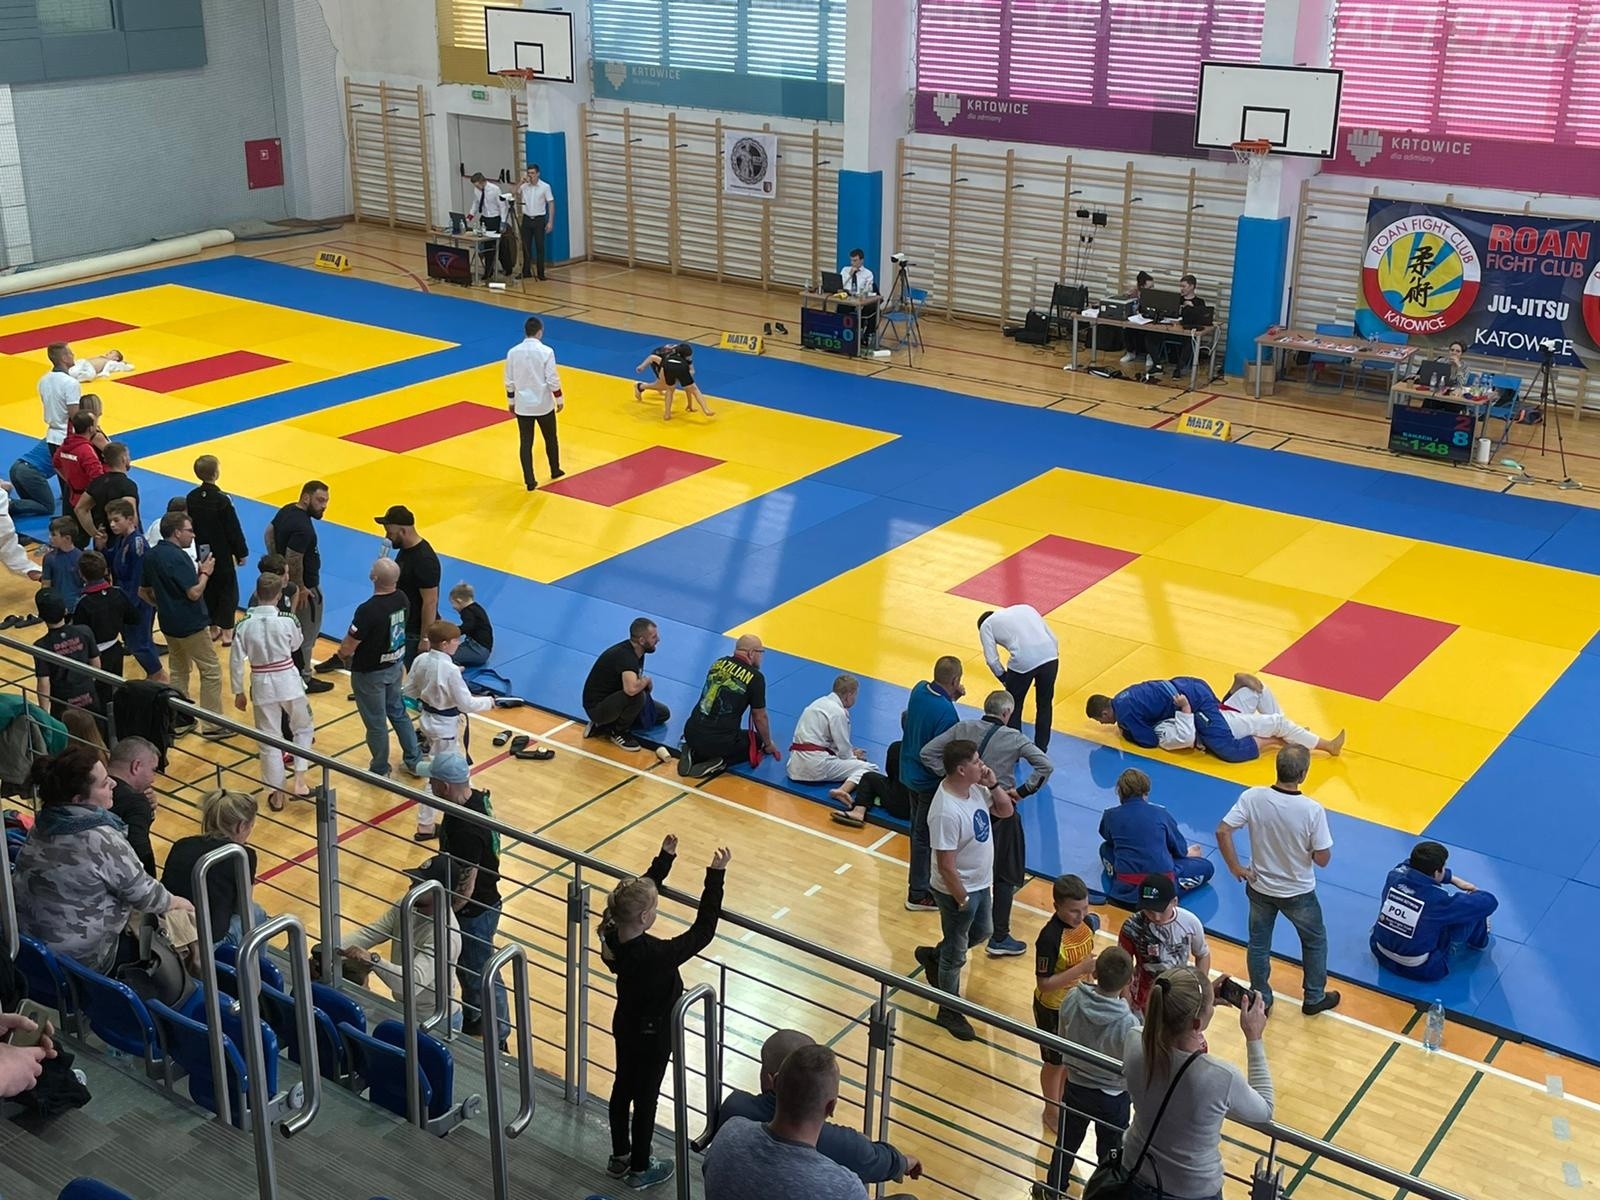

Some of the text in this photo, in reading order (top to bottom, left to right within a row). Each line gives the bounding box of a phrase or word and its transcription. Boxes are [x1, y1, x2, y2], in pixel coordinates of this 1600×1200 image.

[632, 66, 681, 80] KATOWICE
[967, 99, 1029, 115] KATOWICE
[1391, 137, 1472, 155] KATOWICE
[1371, 218, 1474, 264] ROAN FIGHT CLUB
[1488, 223, 1591, 260] ROAN
[320, 252, 342, 268] MATA 4
[1486, 253, 1584, 278] FIGHT CLUB
[1487, 294, 1570, 321] JU-JITSU
[1384, 310, 1447, 331] KATOWICE
[727, 333, 758, 350] MATA 3
[842, 328, 854, 342] 0
[1475, 328, 1574, 356] KATOWCE
[1186, 416, 1225, 437] MATA 2
[1455, 415, 1472, 431] 2
[1453, 430, 1469, 446] 8
[1388, 905, 1407, 920] POL
